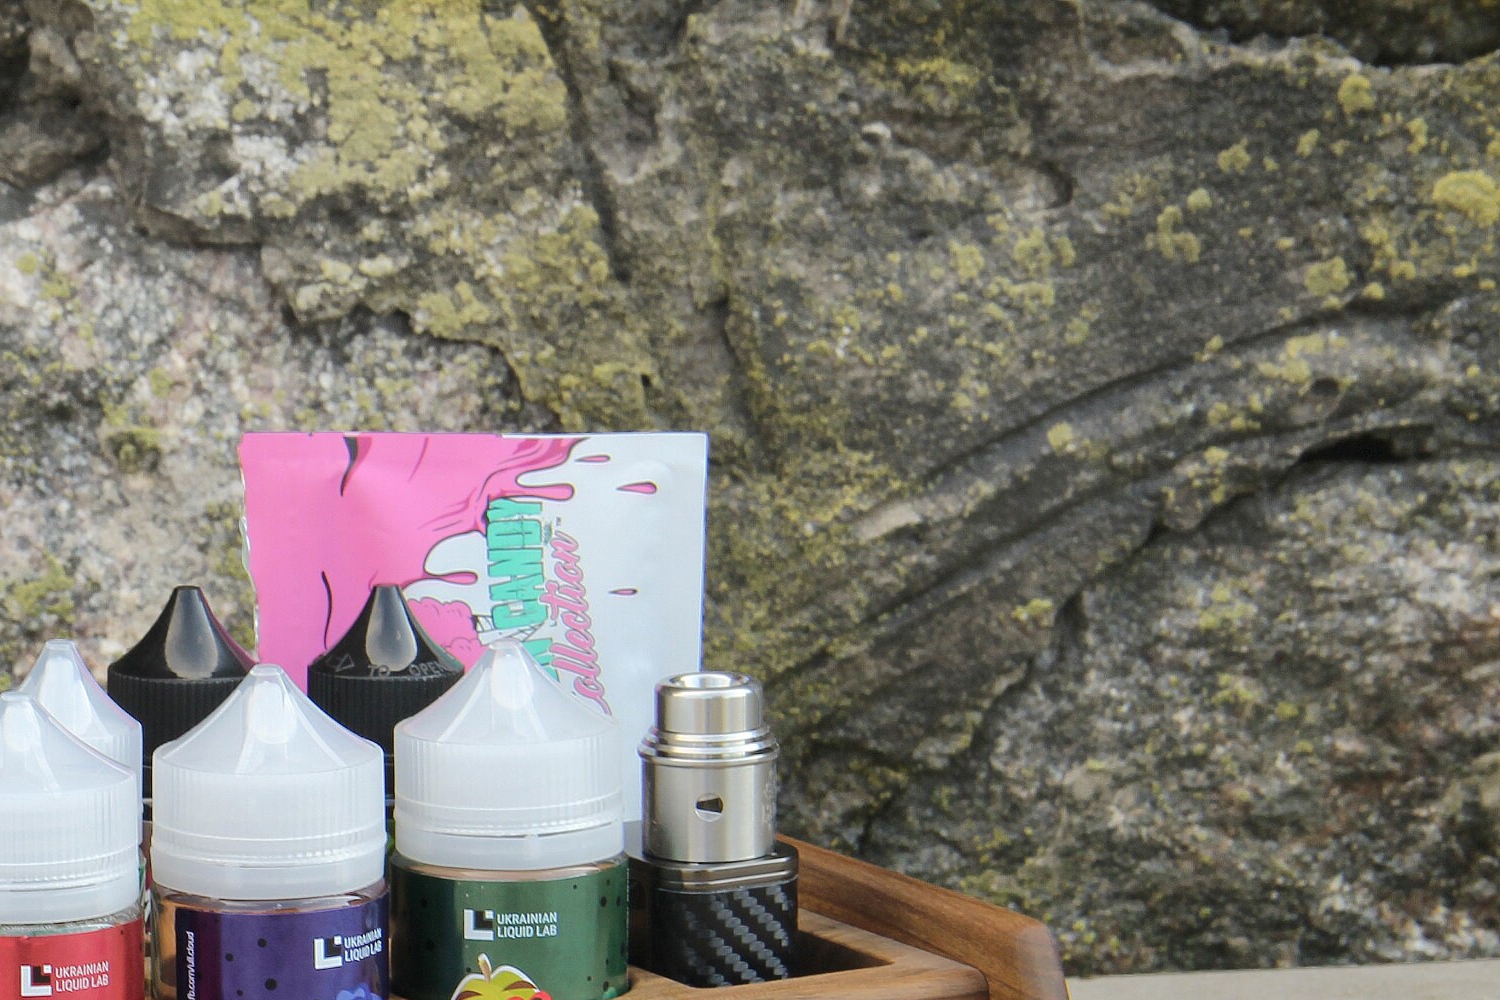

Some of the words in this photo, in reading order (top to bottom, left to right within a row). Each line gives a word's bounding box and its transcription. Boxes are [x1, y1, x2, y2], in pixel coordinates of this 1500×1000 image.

[486, 498, 549, 630] CANDY
[539, 531, 612, 716] ollection
[497, 911, 558, 925] UKRAINIAN
[344, 927, 382, 949] UKRAINIAN
[497, 925, 534, 939] LIQUID
[536, 924, 557, 937] LAB
[344, 942, 369, 962] LIQUID
[370, 940, 382, 957] LAB
[55, 960, 109, 979] UKRAINIAN
[55, 977, 90, 993] LIQUID
[91, 973, 109, 988] LAB
